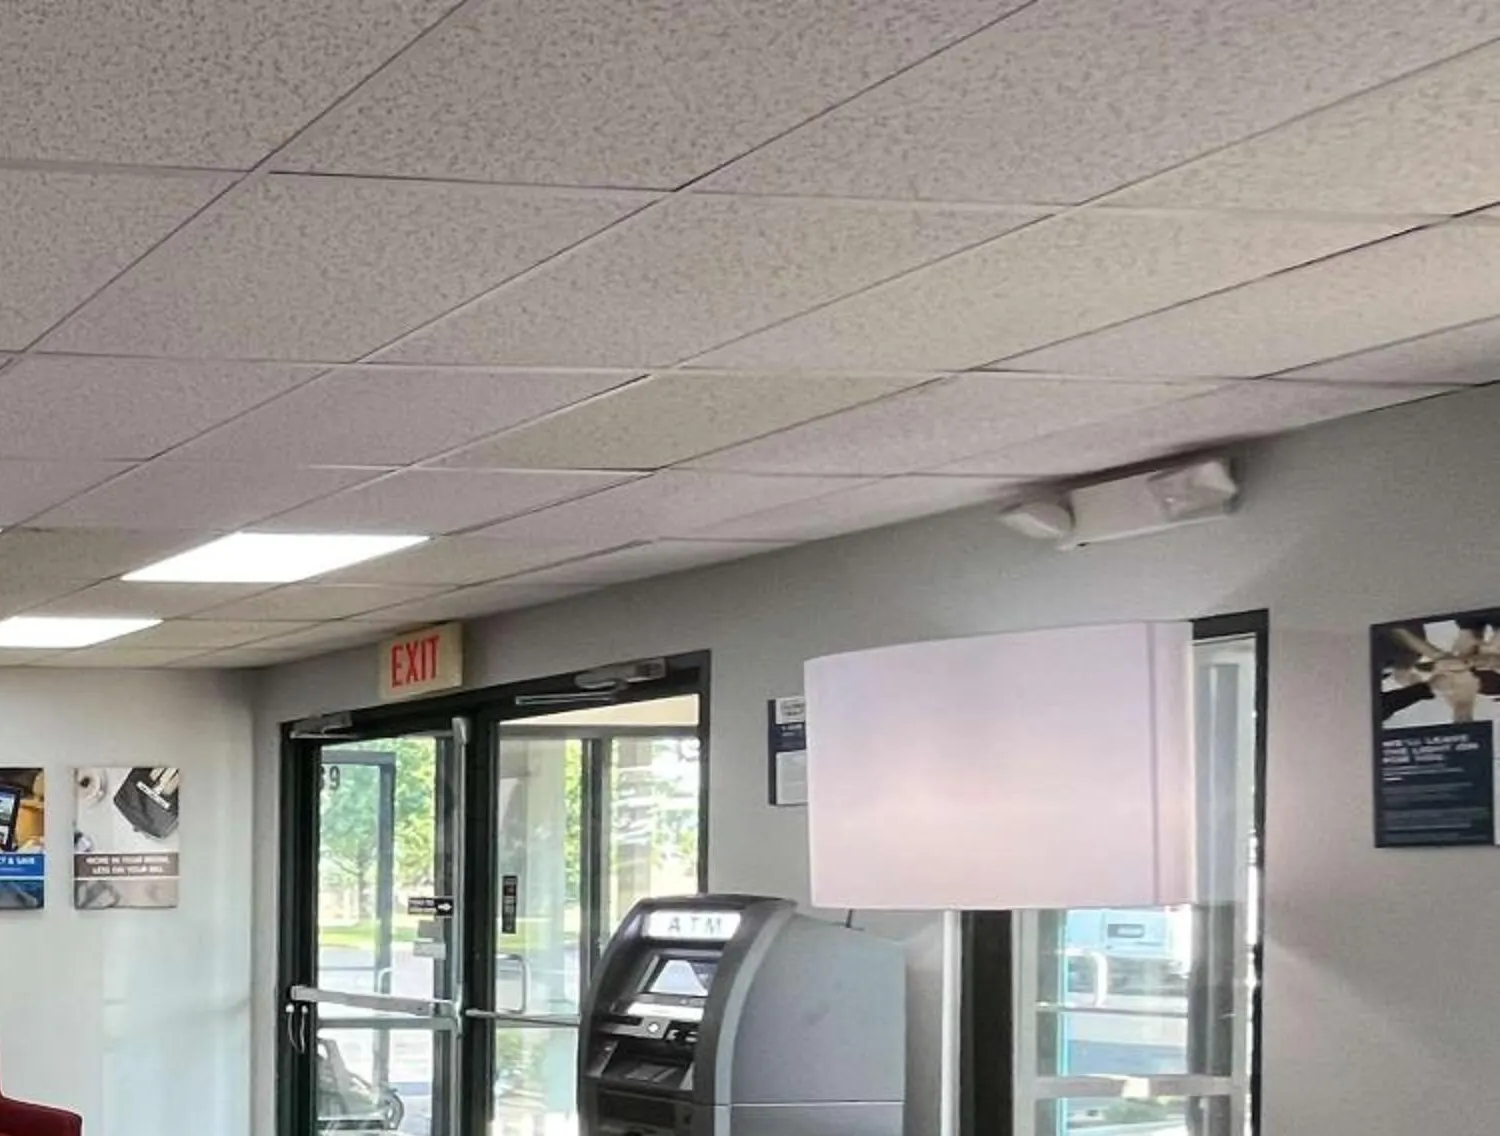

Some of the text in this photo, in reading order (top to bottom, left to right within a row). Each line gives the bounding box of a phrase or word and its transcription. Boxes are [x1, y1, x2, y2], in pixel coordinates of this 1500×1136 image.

[391, 634, 441, 689] EXIT
[16, 856, 35, 865] SAVE
[668, 916, 722, 933] ATM
